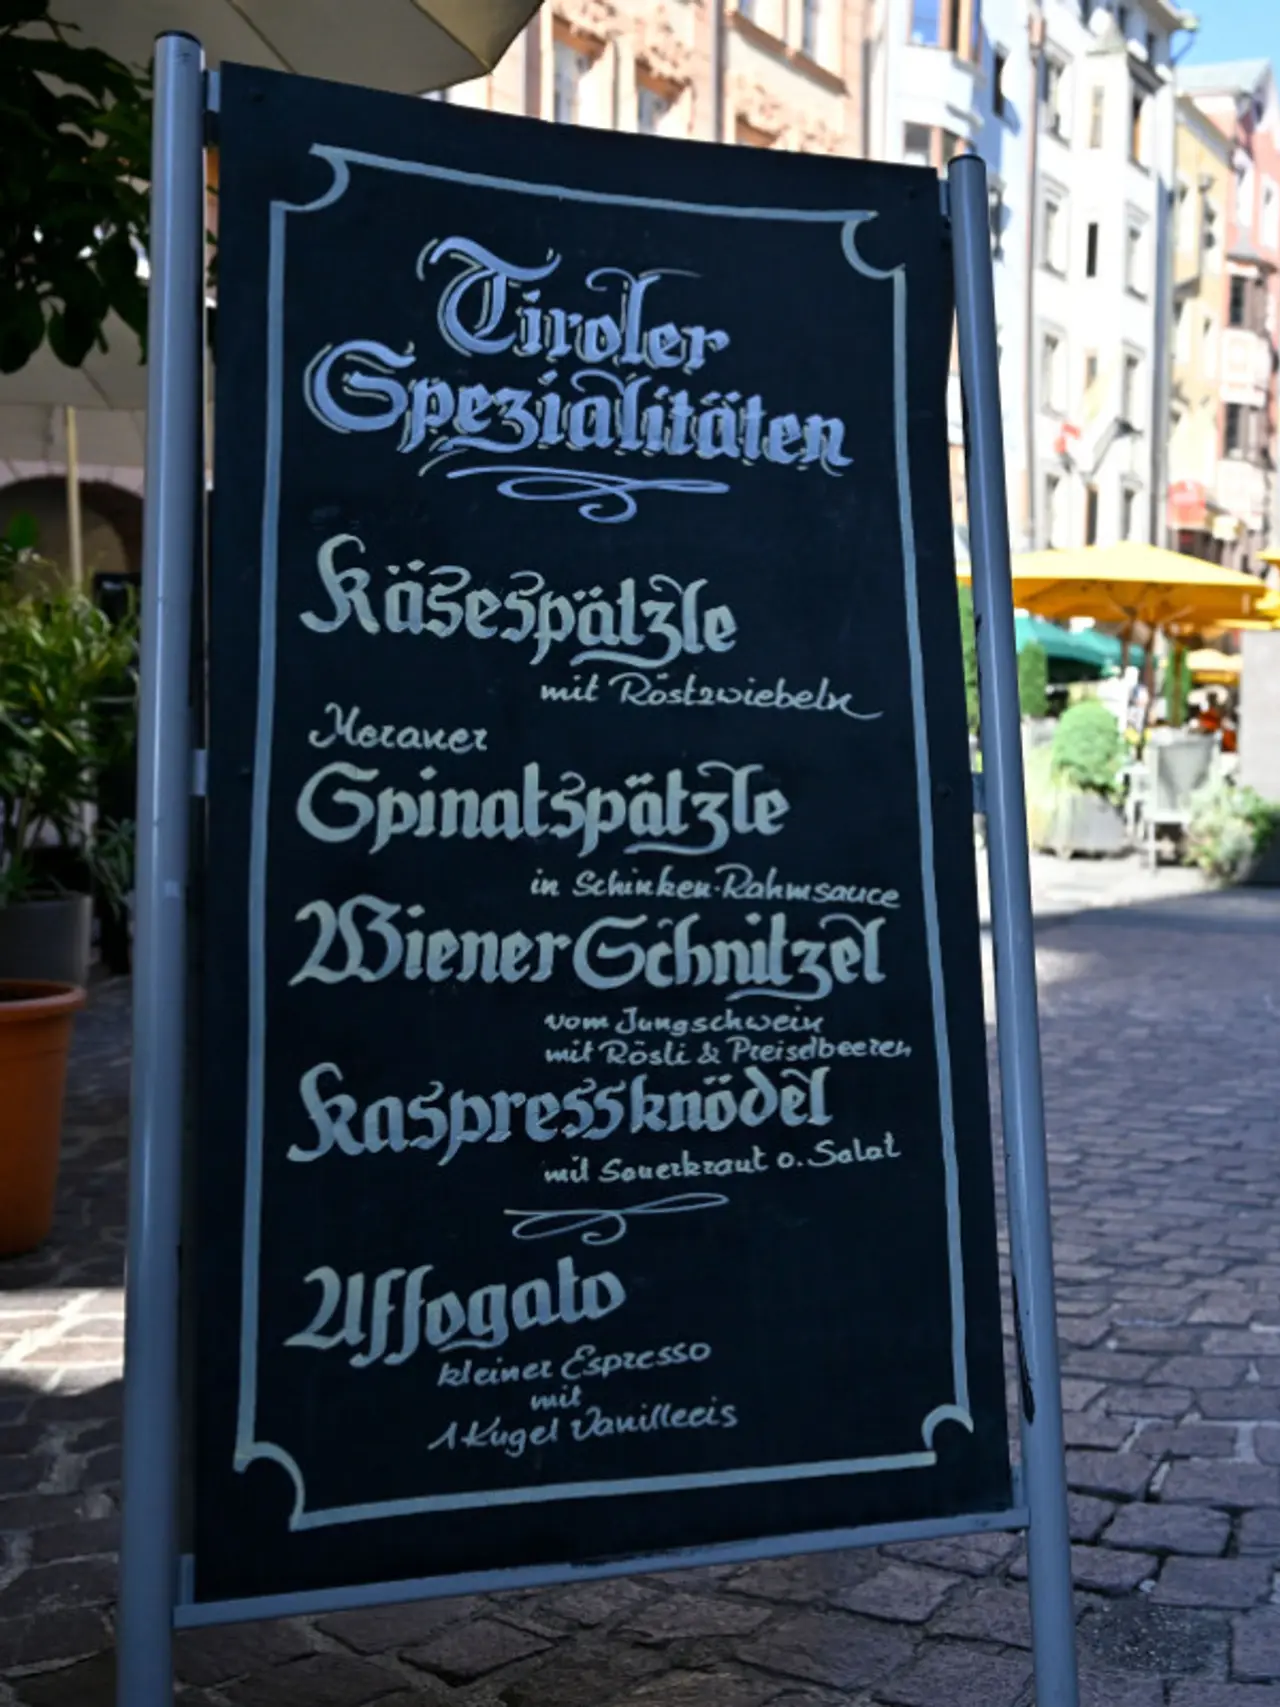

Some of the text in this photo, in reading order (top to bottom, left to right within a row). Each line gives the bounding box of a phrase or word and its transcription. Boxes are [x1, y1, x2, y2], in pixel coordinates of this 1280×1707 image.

[416, 236, 730, 373] Tiroler
[304, 339, 854, 477] Spezialitäten
[300, 534, 737, 668] Käsespätzle
[541, 672, 882, 719] mit Röstzwiebeln
[309, 703, 487, 753] Meraner
[297, 761, 789, 857] Spinatspätzle
[531, 869, 559, 896] in
[290, 894, 885, 1001] Wiener Schnitzel
[544, 1006, 825, 1037] vom Jungschwein
[546, 1040, 593, 1063] mit
[287, 1061, 833, 1165] Kaspressknödel
[545, 1156, 588, 1182] mit
[600, 1146, 768, 1181] Sauerkraut
[808, 1132, 901, 1166] Salat
[438, 1343, 710, 1385] kleiner Espresso
[531, 1386, 581, 1409] mit
[462, 1417, 558, 1456] Kugel
[568, 1395, 737, 1440] Vanilleeis
